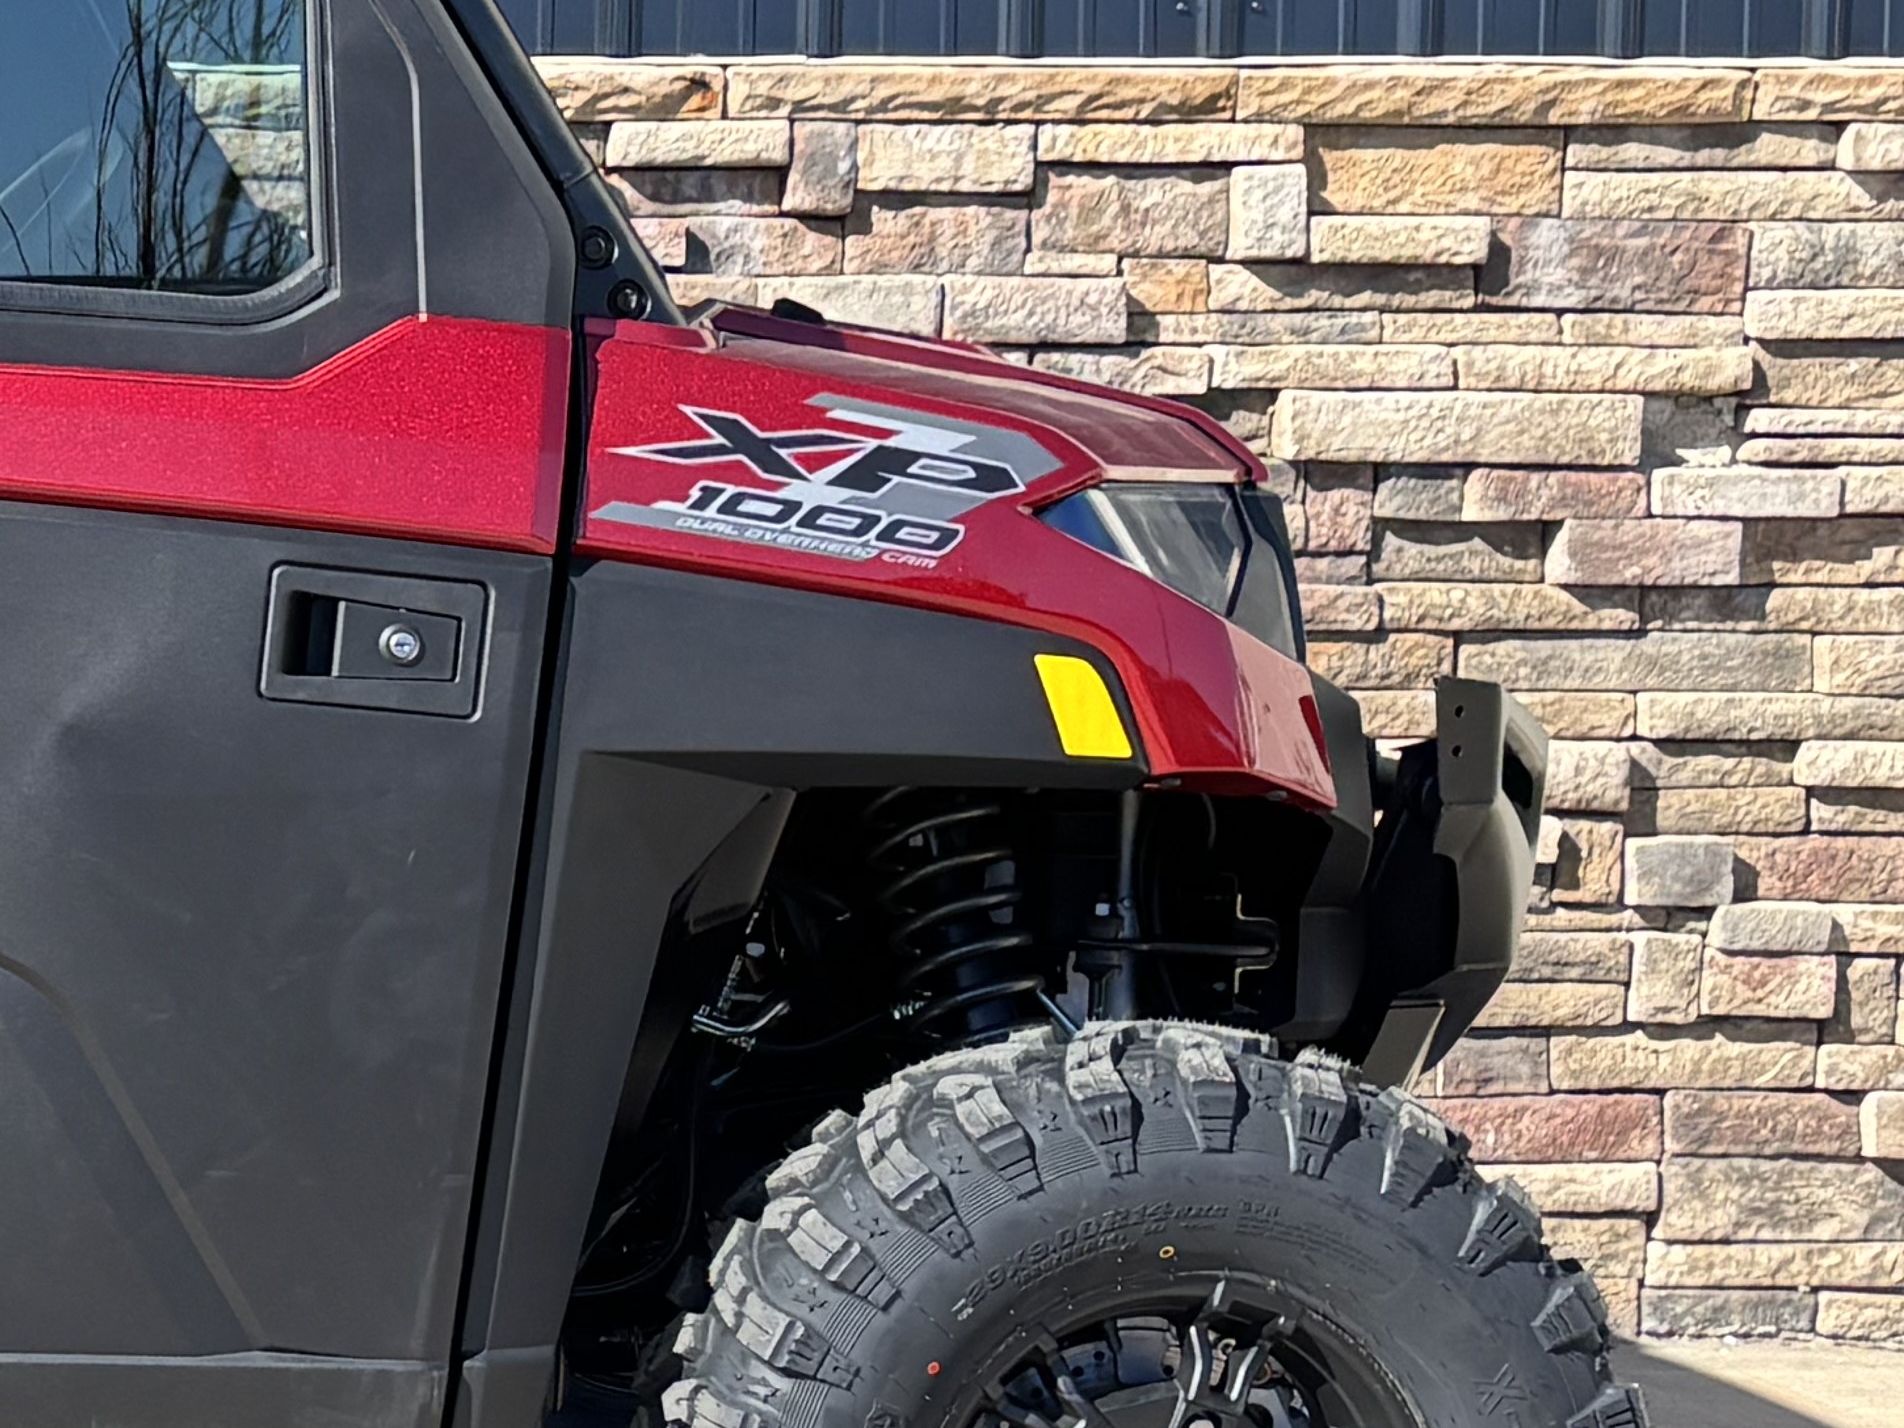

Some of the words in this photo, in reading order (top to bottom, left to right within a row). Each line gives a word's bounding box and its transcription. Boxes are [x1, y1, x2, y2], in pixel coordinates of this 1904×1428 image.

[605, 404, 1026, 499] XP
[675, 515, 741, 536] DUAL
[880, 551, 938, 570] CAM
[681, 481, 966, 557] 1000
